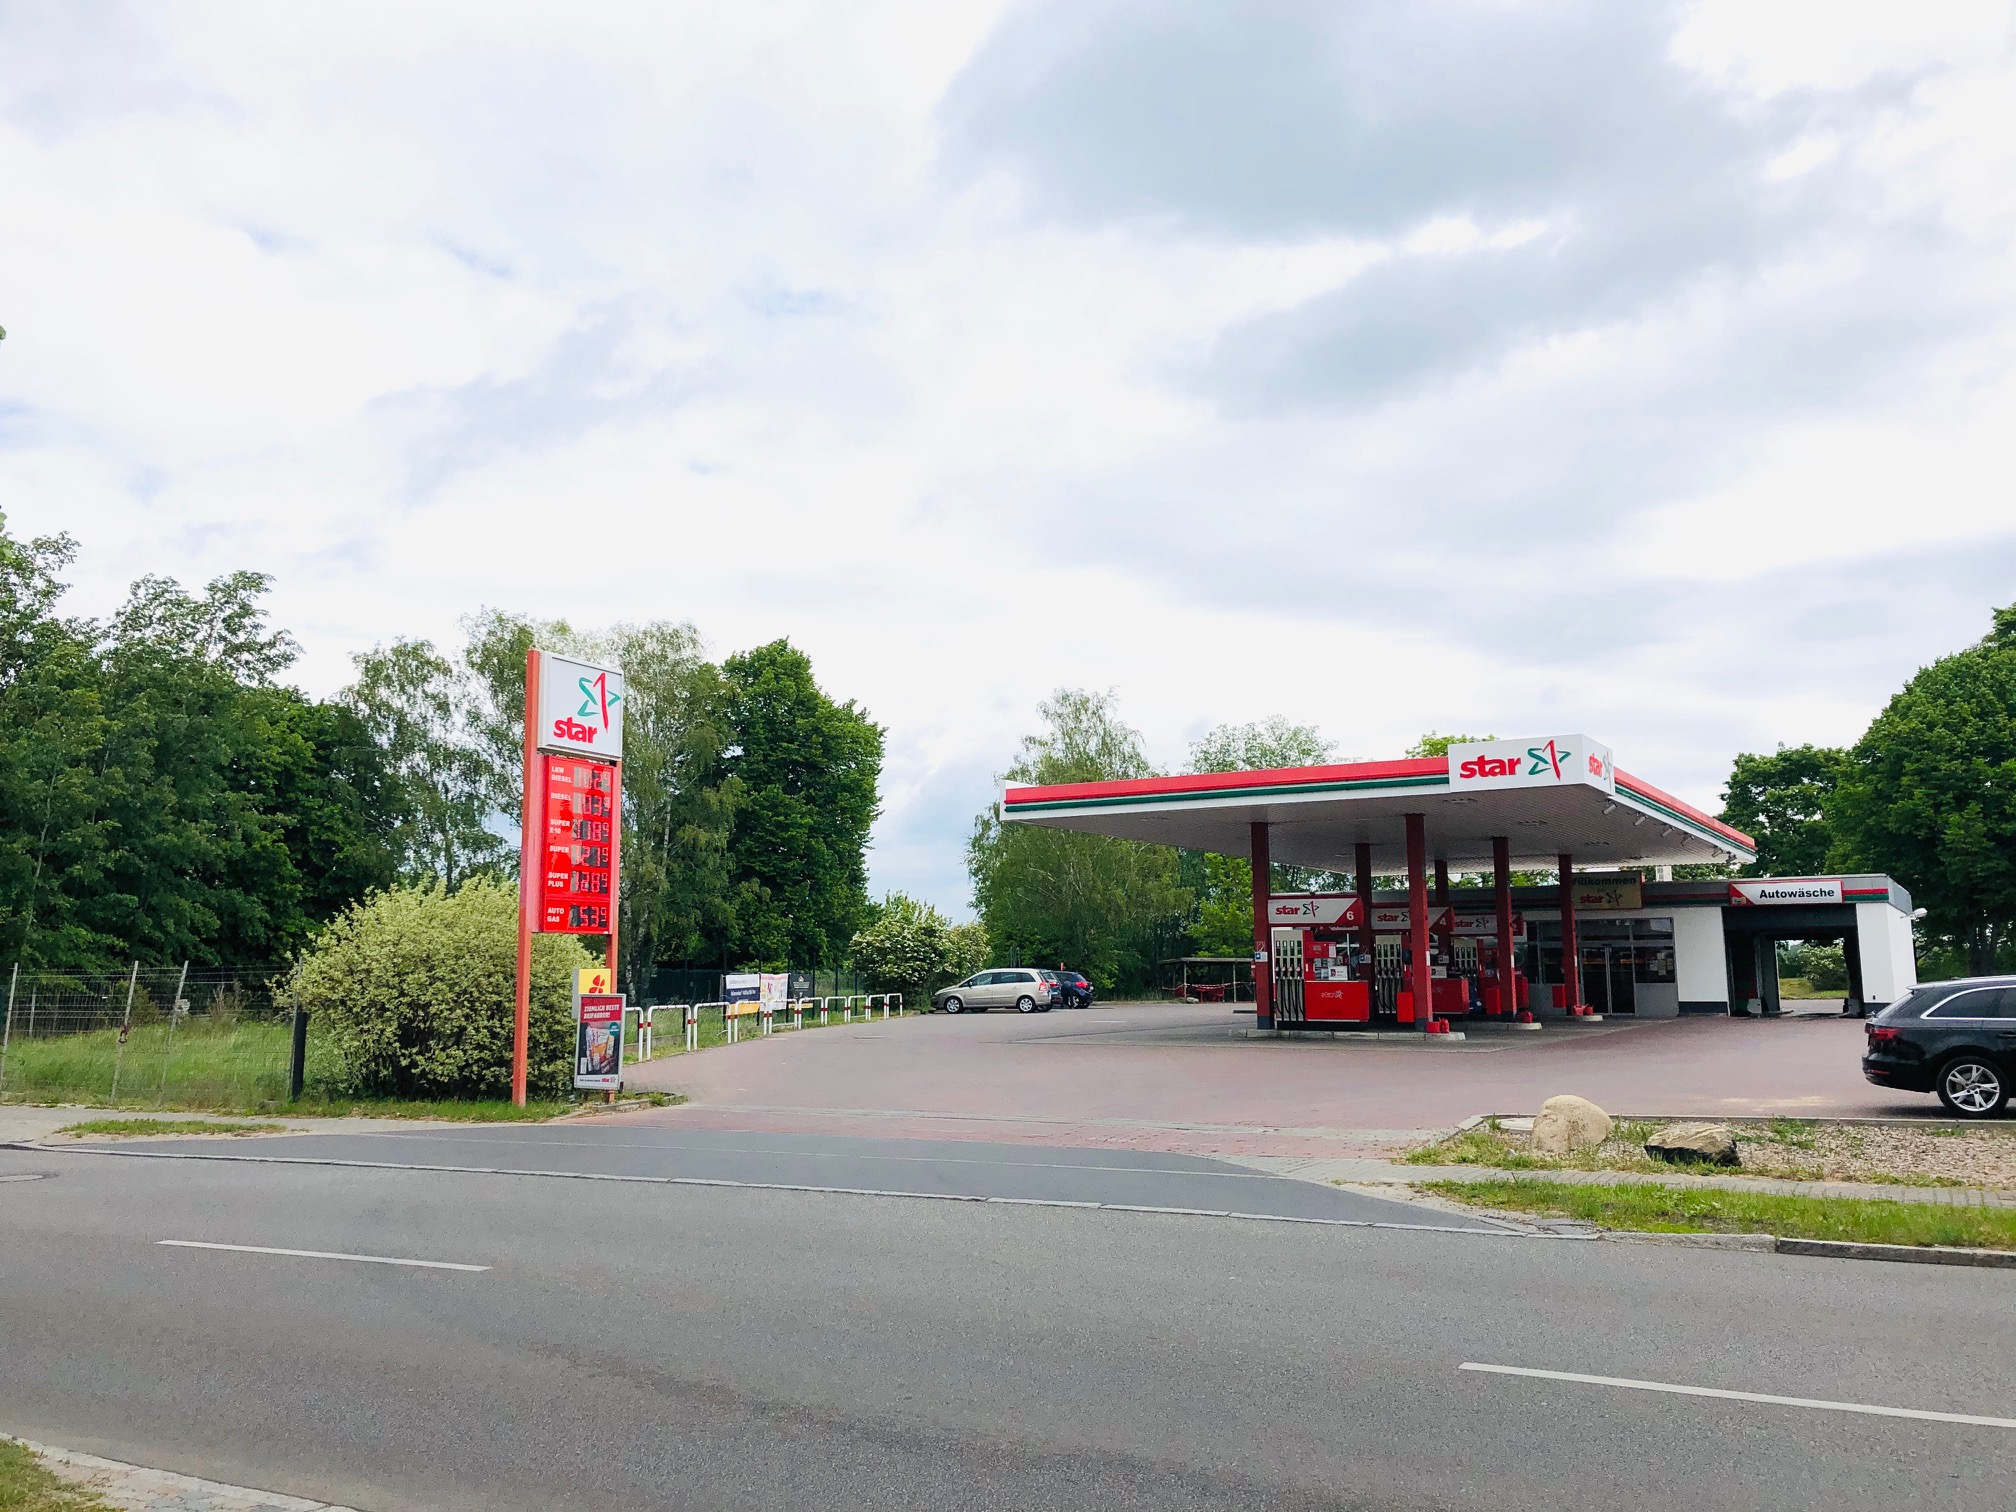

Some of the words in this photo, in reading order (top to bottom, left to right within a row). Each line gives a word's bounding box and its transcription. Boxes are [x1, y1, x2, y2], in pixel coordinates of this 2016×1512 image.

[553, 717, 598, 744] star
[1459, 755, 1522, 779] star
[1589, 752, 1603, 777] star
[551, 766, 565, 774] LKW
[551, 774, 573, 783] DIESEL
[550, 792, 572, 801] DIESEL
[550, 818, 571, 827] SUPER
[549, 845, 570, 853] SUPER
[548, 872, 569, 880] SUPER
[547, 880, 564, 888] PLUS
[1759, 887, 1835, 899] Autowäsche
[1579, 894, 1604, 904] star
[547, 907, 565, 915] AUTO
[1275, 905, 1301, 915] star
[547, 915, 560, 923] GAS
[1346, 911, 1354, 921] 6
[1377, 913, 1399, 922] star
[1440, 917, 1447, 926] 4
[1454, 920, 1474, 928] star
